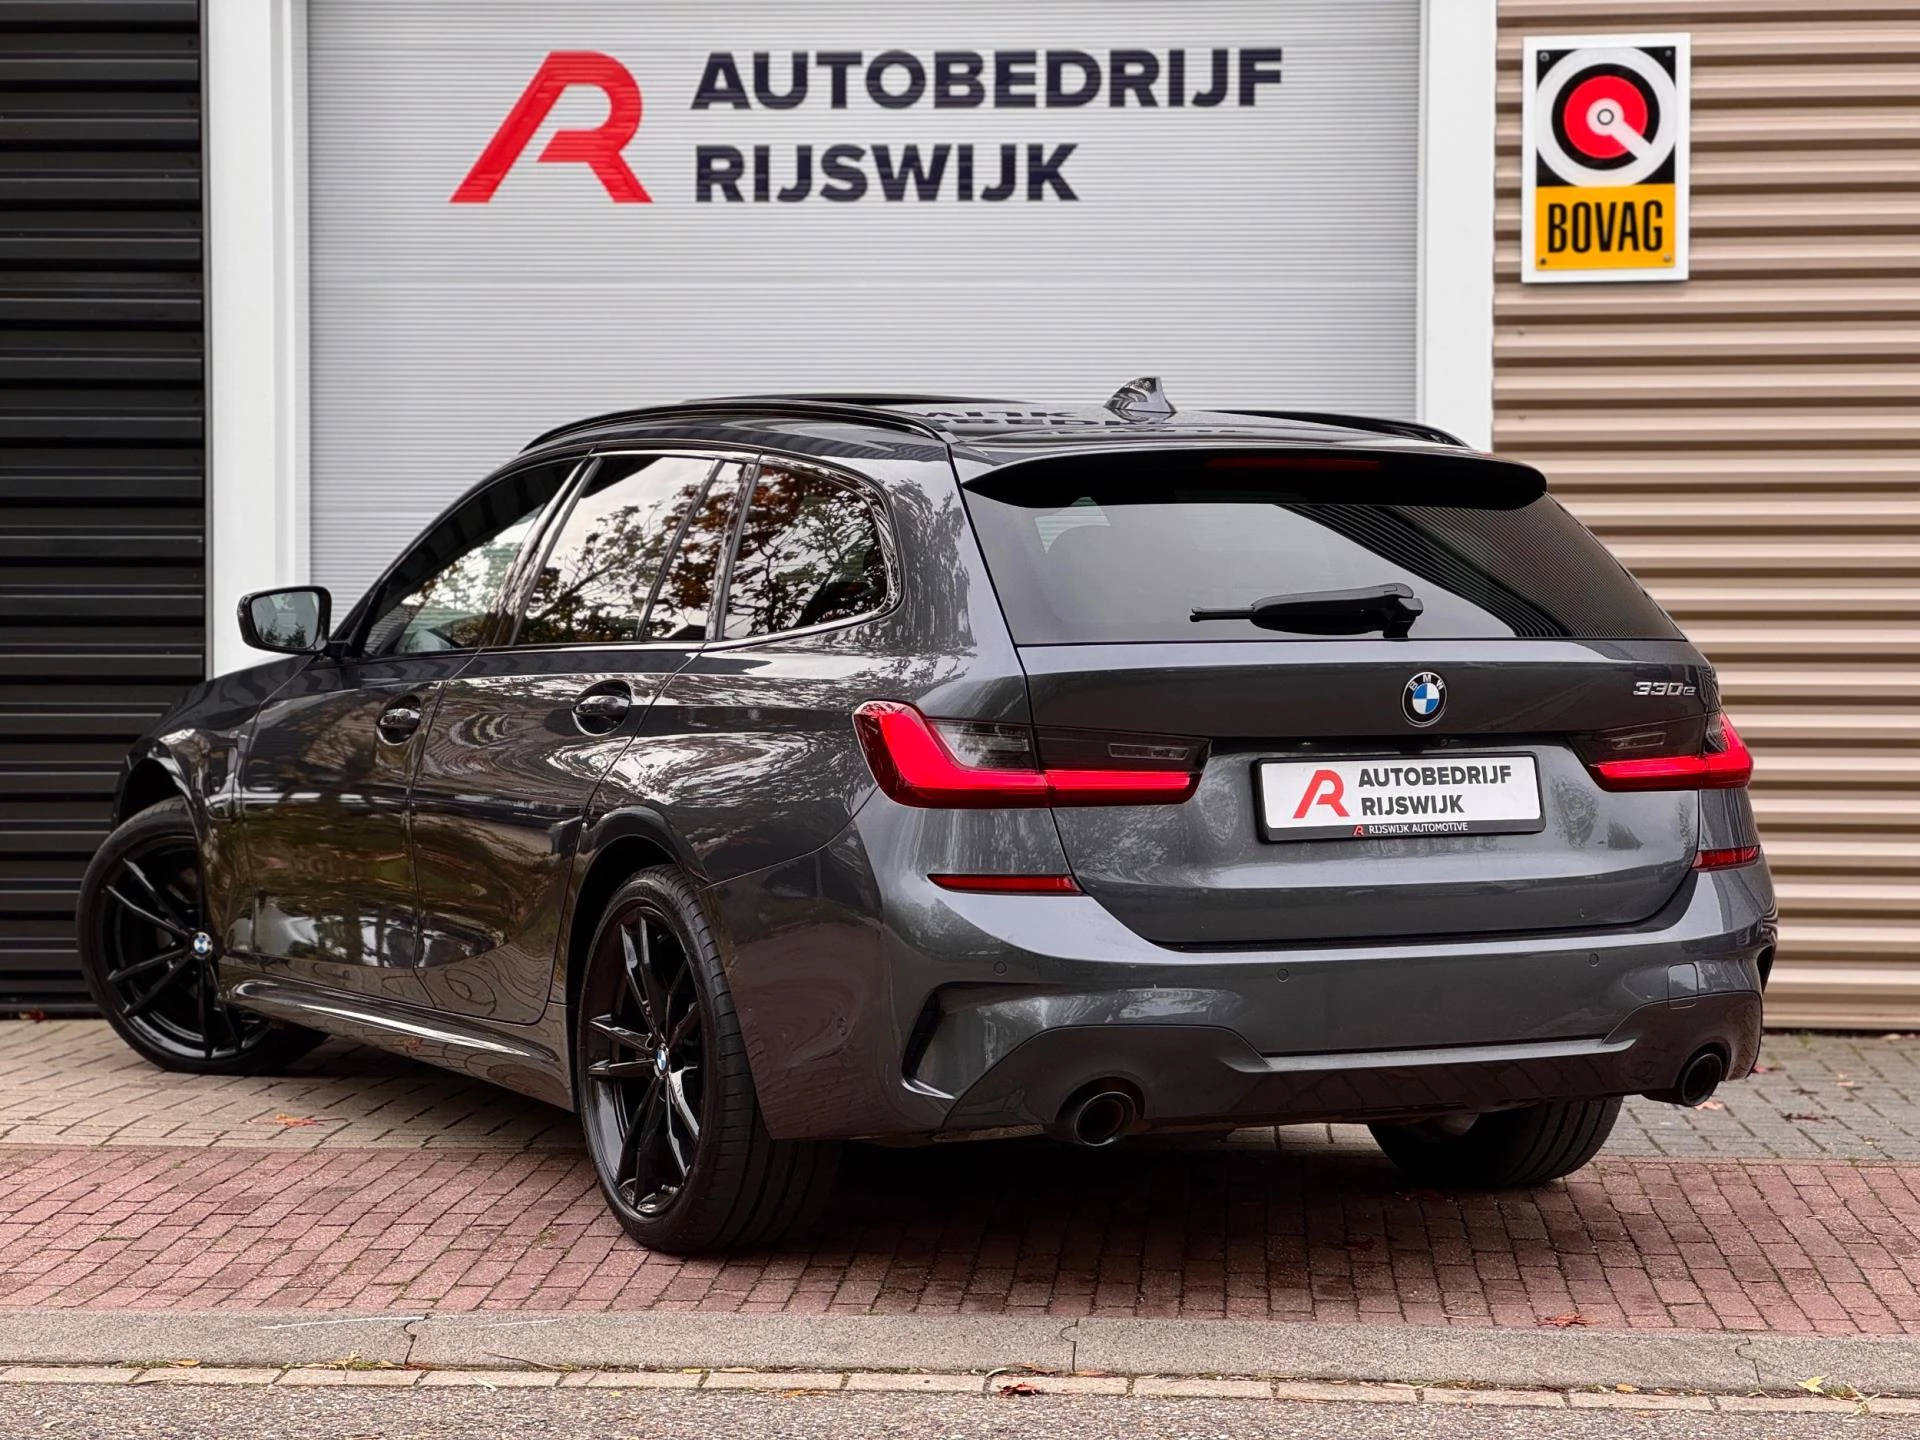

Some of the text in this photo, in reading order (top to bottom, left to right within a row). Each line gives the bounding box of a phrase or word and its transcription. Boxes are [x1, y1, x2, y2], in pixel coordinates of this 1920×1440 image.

[690, 47, 1283, 110] AUTOBEDRIJF
[695, 143, 1080, 203] RIJSWIJK
[1547, 200, 1664, 253] BOVAG
[1408, 674, 1445, 691] BMW
[1633, 681, 1697, 696] 330e
[1358, 765, 1512, 788] AUTOBEDRIJF
[1360, 795, 1465, 816] RIJSWIJK
[1368, 822, 1469, 834] RIJSWIJK AUTOMOTIVE
